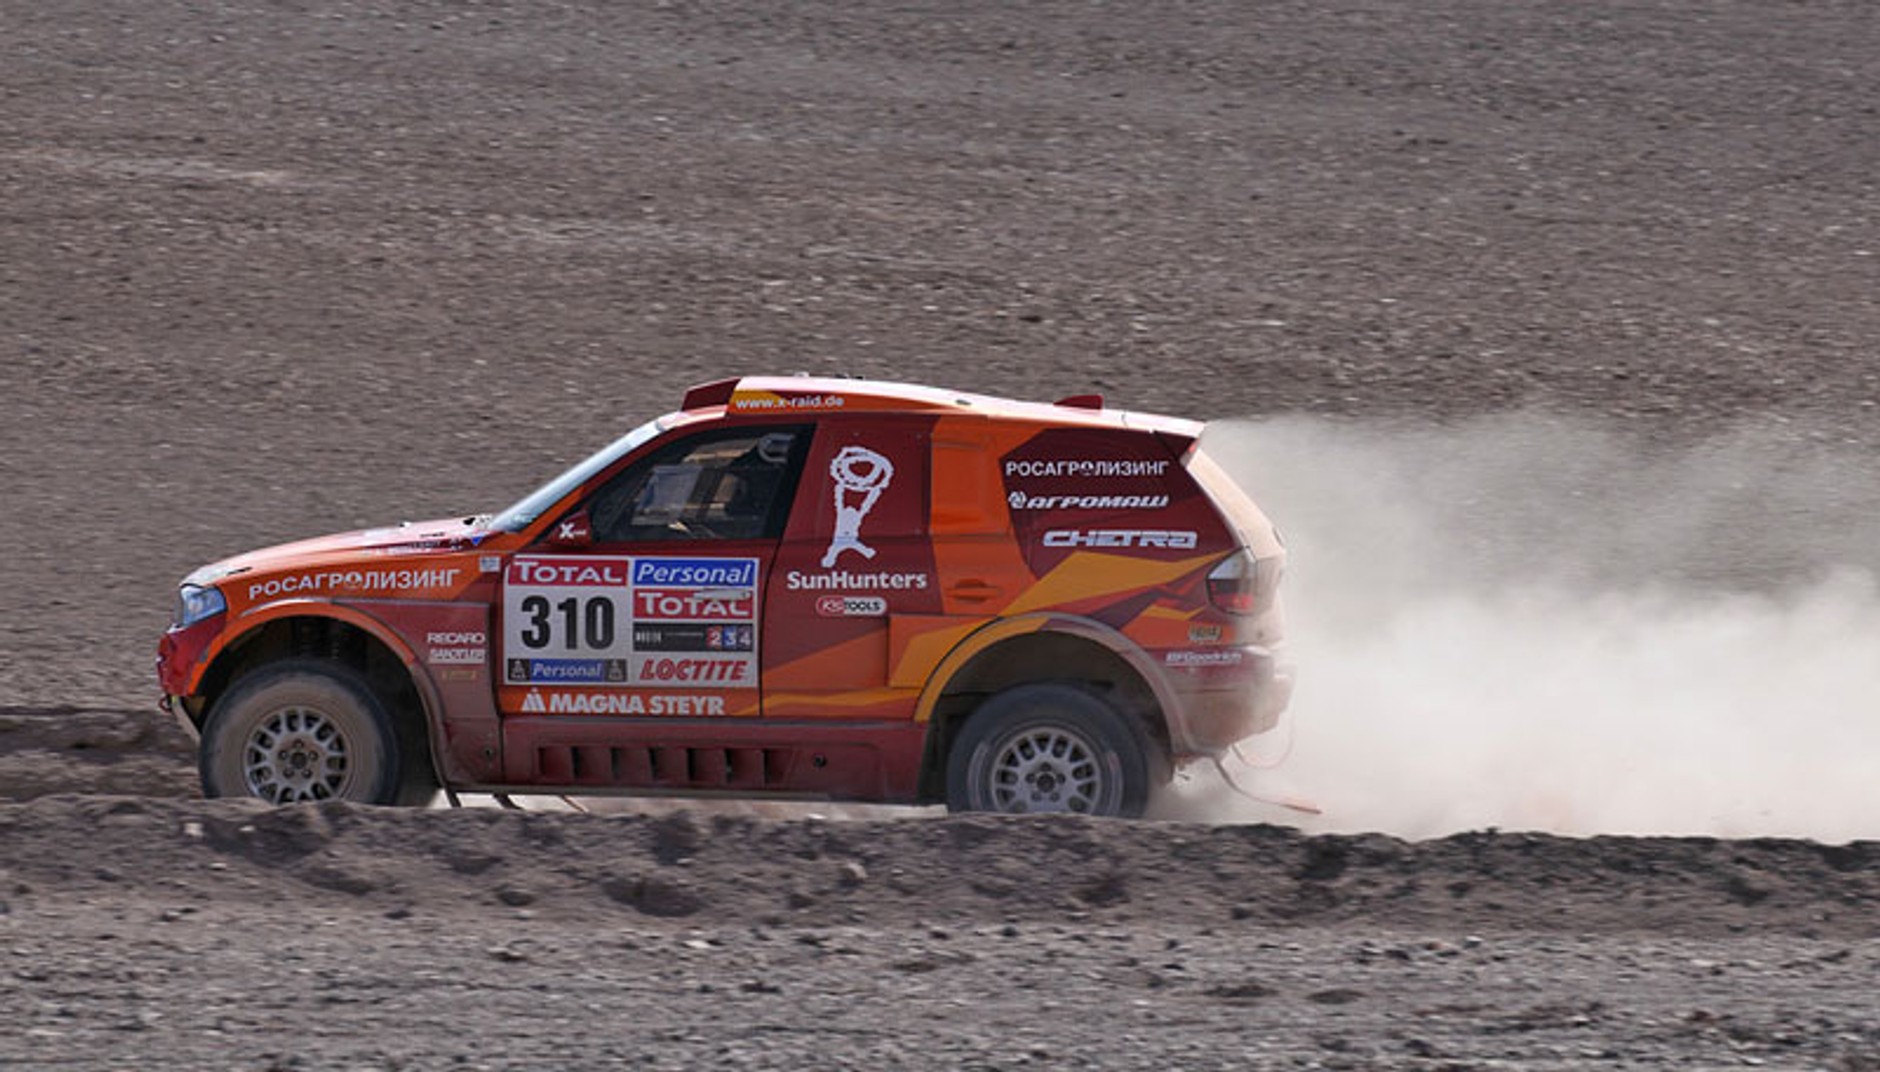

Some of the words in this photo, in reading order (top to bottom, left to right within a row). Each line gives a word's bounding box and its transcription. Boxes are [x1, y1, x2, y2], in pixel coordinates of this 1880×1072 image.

[1005, 460, 1169, 477] РОСАГРОЛИЗИНГ
[513, 561, 622, 583] TOTAL
[637, 562, 752, 584] Personal
[786, 570, 928, 590] SunHunters
[249, 568, 461, 600] РОСАГРОЛИЗИНГ
[521, 595, 614, 650] 310
[533, 662, 601, 677] Personal
[639, 658, 748, 681] LOCTITE
[550, 694, 645, 714] MAGNA
[649, 696, 725, 715] STEYR
